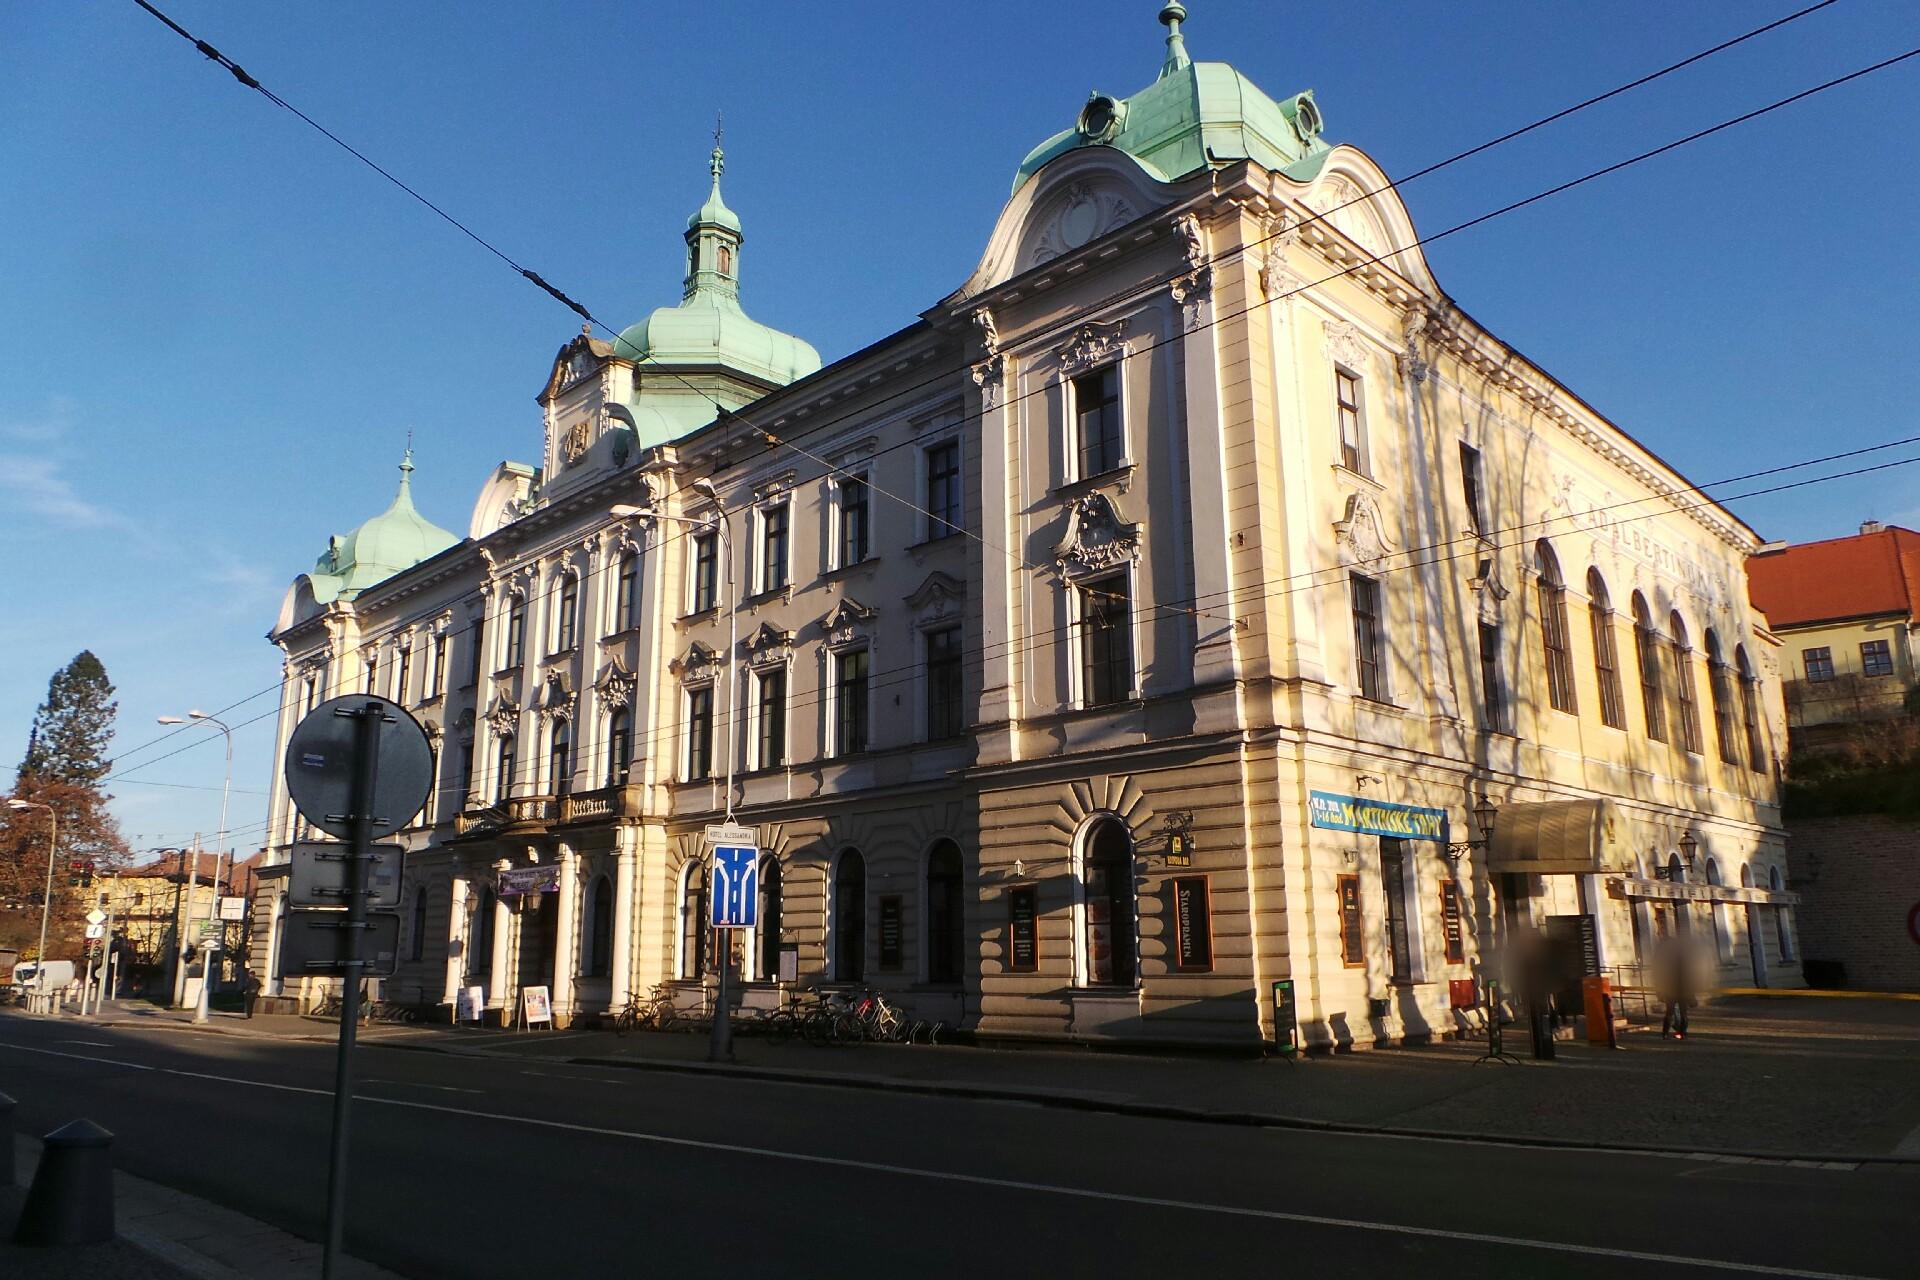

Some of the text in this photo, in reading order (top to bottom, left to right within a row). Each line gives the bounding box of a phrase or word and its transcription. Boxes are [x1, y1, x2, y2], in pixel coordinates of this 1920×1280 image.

[1588, 502, 1711, 592] ADALBERTINUM
[710, 831, 722, 839] HOTEL
[1342, 803, 1413, 833] MARTINSKÉ
[1180, 889, 1192, 958] STAROPRAMEN
